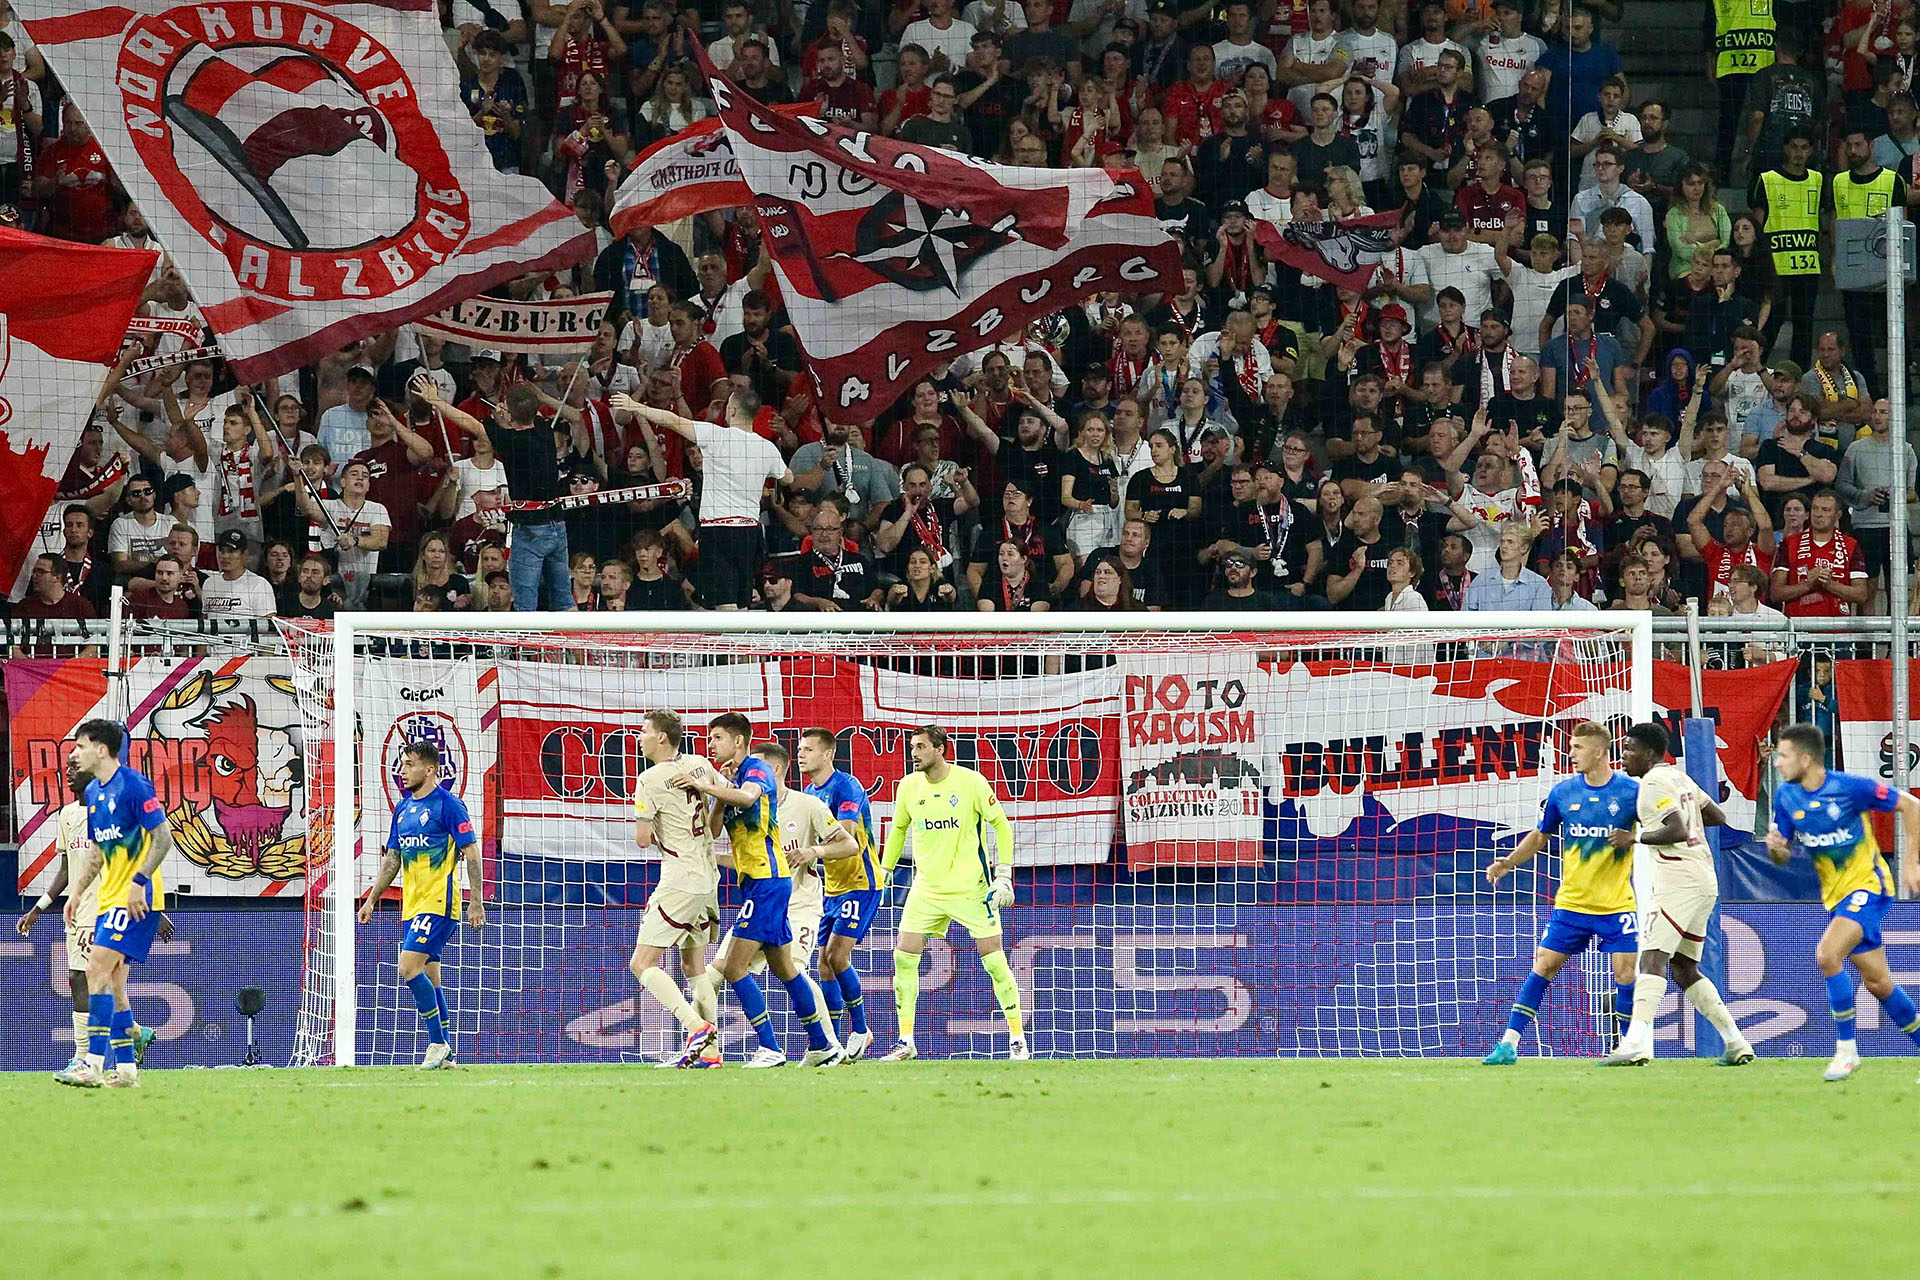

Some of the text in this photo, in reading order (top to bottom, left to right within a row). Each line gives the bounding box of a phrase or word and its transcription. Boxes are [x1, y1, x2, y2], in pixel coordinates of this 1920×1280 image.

[1716, 32, 1775, 48] EWARD
[1731, 53, 1757, 67] 122
[1791, 254, 1817, 270] 132
[1126, 674, 1248, 712] NO TO
[1127, 709, 1256, 748] RACISM
[539, 720, 1104, 801] COCTIVO
[1129, 789, 1218, 808] COLLECTIVO
[1131, 790, 1259, 822] SALZBURG 2011
[103, 907, 129, 932] 10
[841, 900, 861, 921] 91
[410, 915, 433, 936] 44
